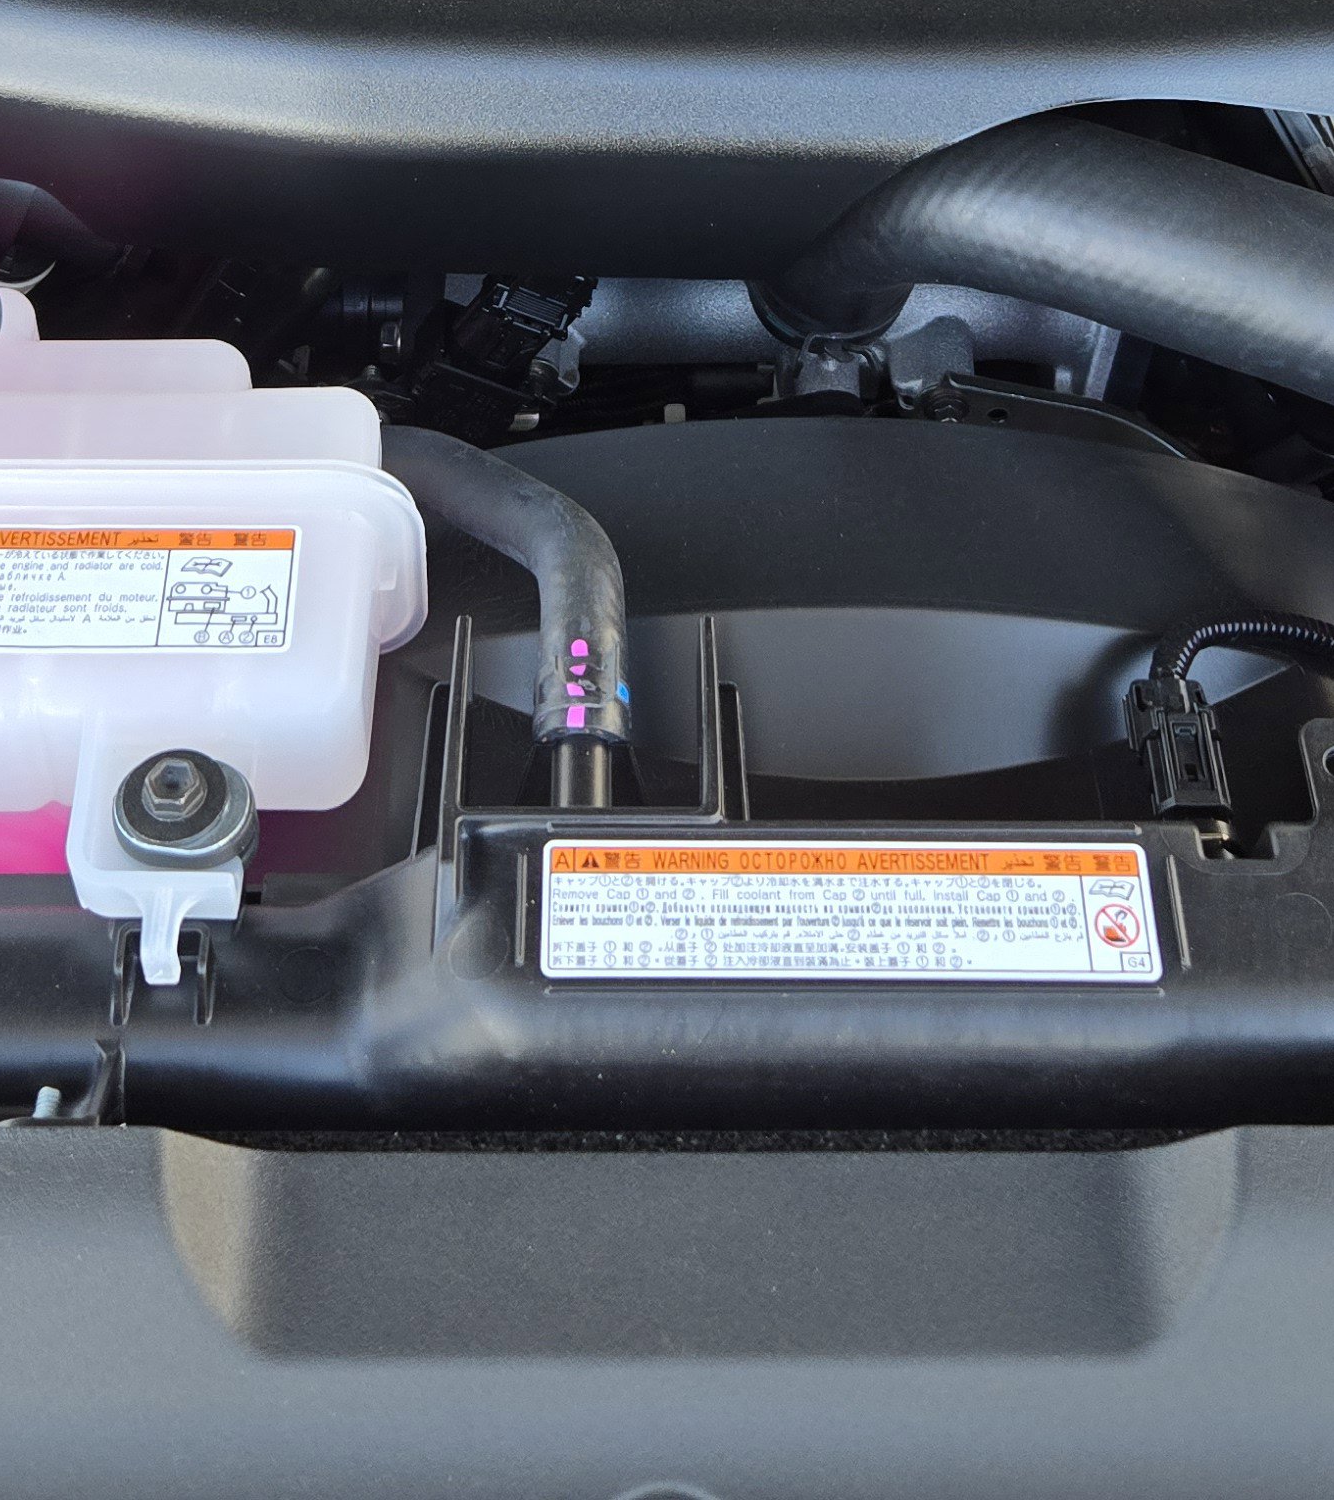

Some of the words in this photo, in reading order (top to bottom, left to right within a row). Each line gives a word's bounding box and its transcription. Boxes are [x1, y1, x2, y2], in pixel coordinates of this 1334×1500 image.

[11, 562, 43, 571] engine
[50, 562, 69, 571] and
[74, 562, 113, 571] radiator
[140, 562, 164, 571] cold.
[11, 592, 91, 602] refroidissement
[98, 592, 112, 602] du
[119, 593, 158, 602] moteur.
[7, 603, 56, 613] radiateur
[63, 604, 87, 613] sont
[94, 603, 127, 613] froids.
[264, 635, 278, 644] E8
[555, 852, 570, 869] A
[653, 852, 730, 870] WARNING
[740, 852, 847, 870] ОСТОРОЖНО
[857, 852, 989, 871] AVERTISSEMENT
[553, 888, 598, 899] Remove
[607, 888, 630, 900] Cap
[655, 888, 676, 899] and
[712, 888, 729, 899] Fill
[737, 888, 781, 899] coolant
[789, 888, 814, 899] from
[823, 889, 846, 901] Cap
[871, 889, 895, 900] until
[934, 889, 968, 900] Install
[977, 890, 1000, 902] Cap
[1025, 890, 1047, 900] and
[1127, 956, 1146, 969] G4
